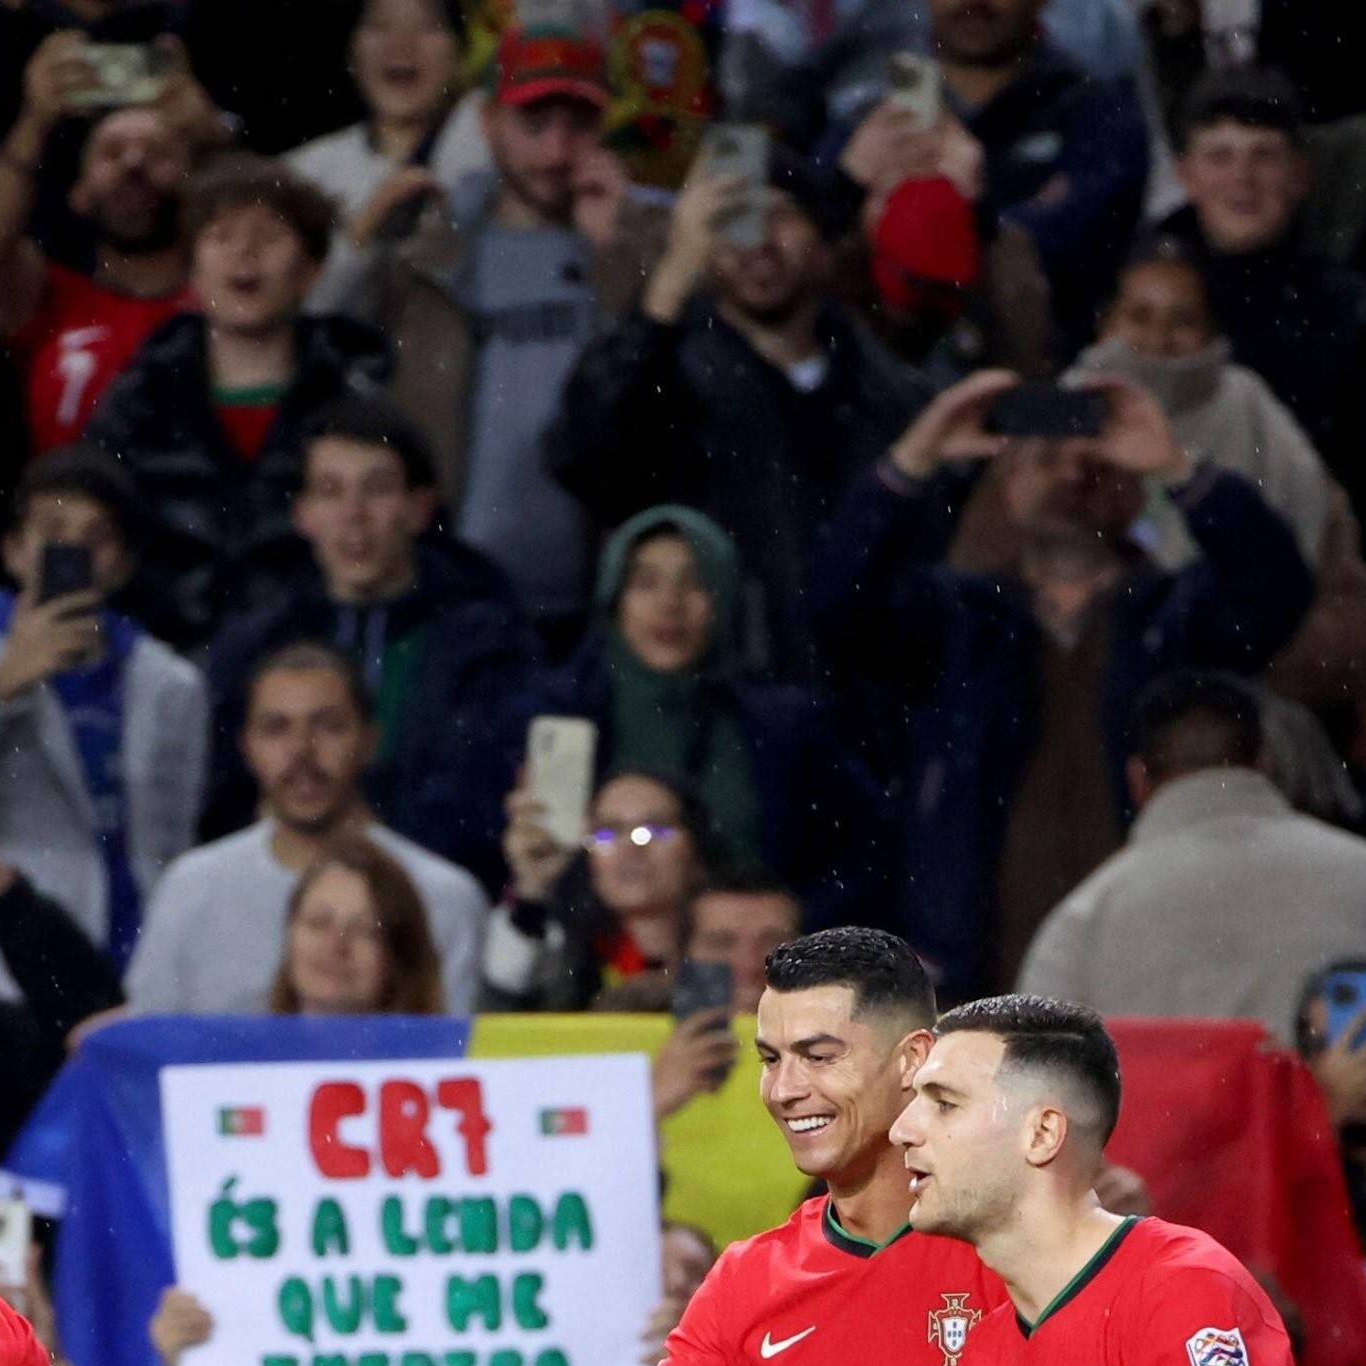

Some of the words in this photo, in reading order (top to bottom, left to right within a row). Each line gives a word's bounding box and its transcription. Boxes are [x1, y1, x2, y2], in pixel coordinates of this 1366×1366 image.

[309, 1078, 492, 1179] CR7
[312, 1196, 350, 1257] A
[382, 1192, 593, 1256] LENDA
[278, 1274, 408, 1343] QUE
[446, 1272, 549, 1333] ME
